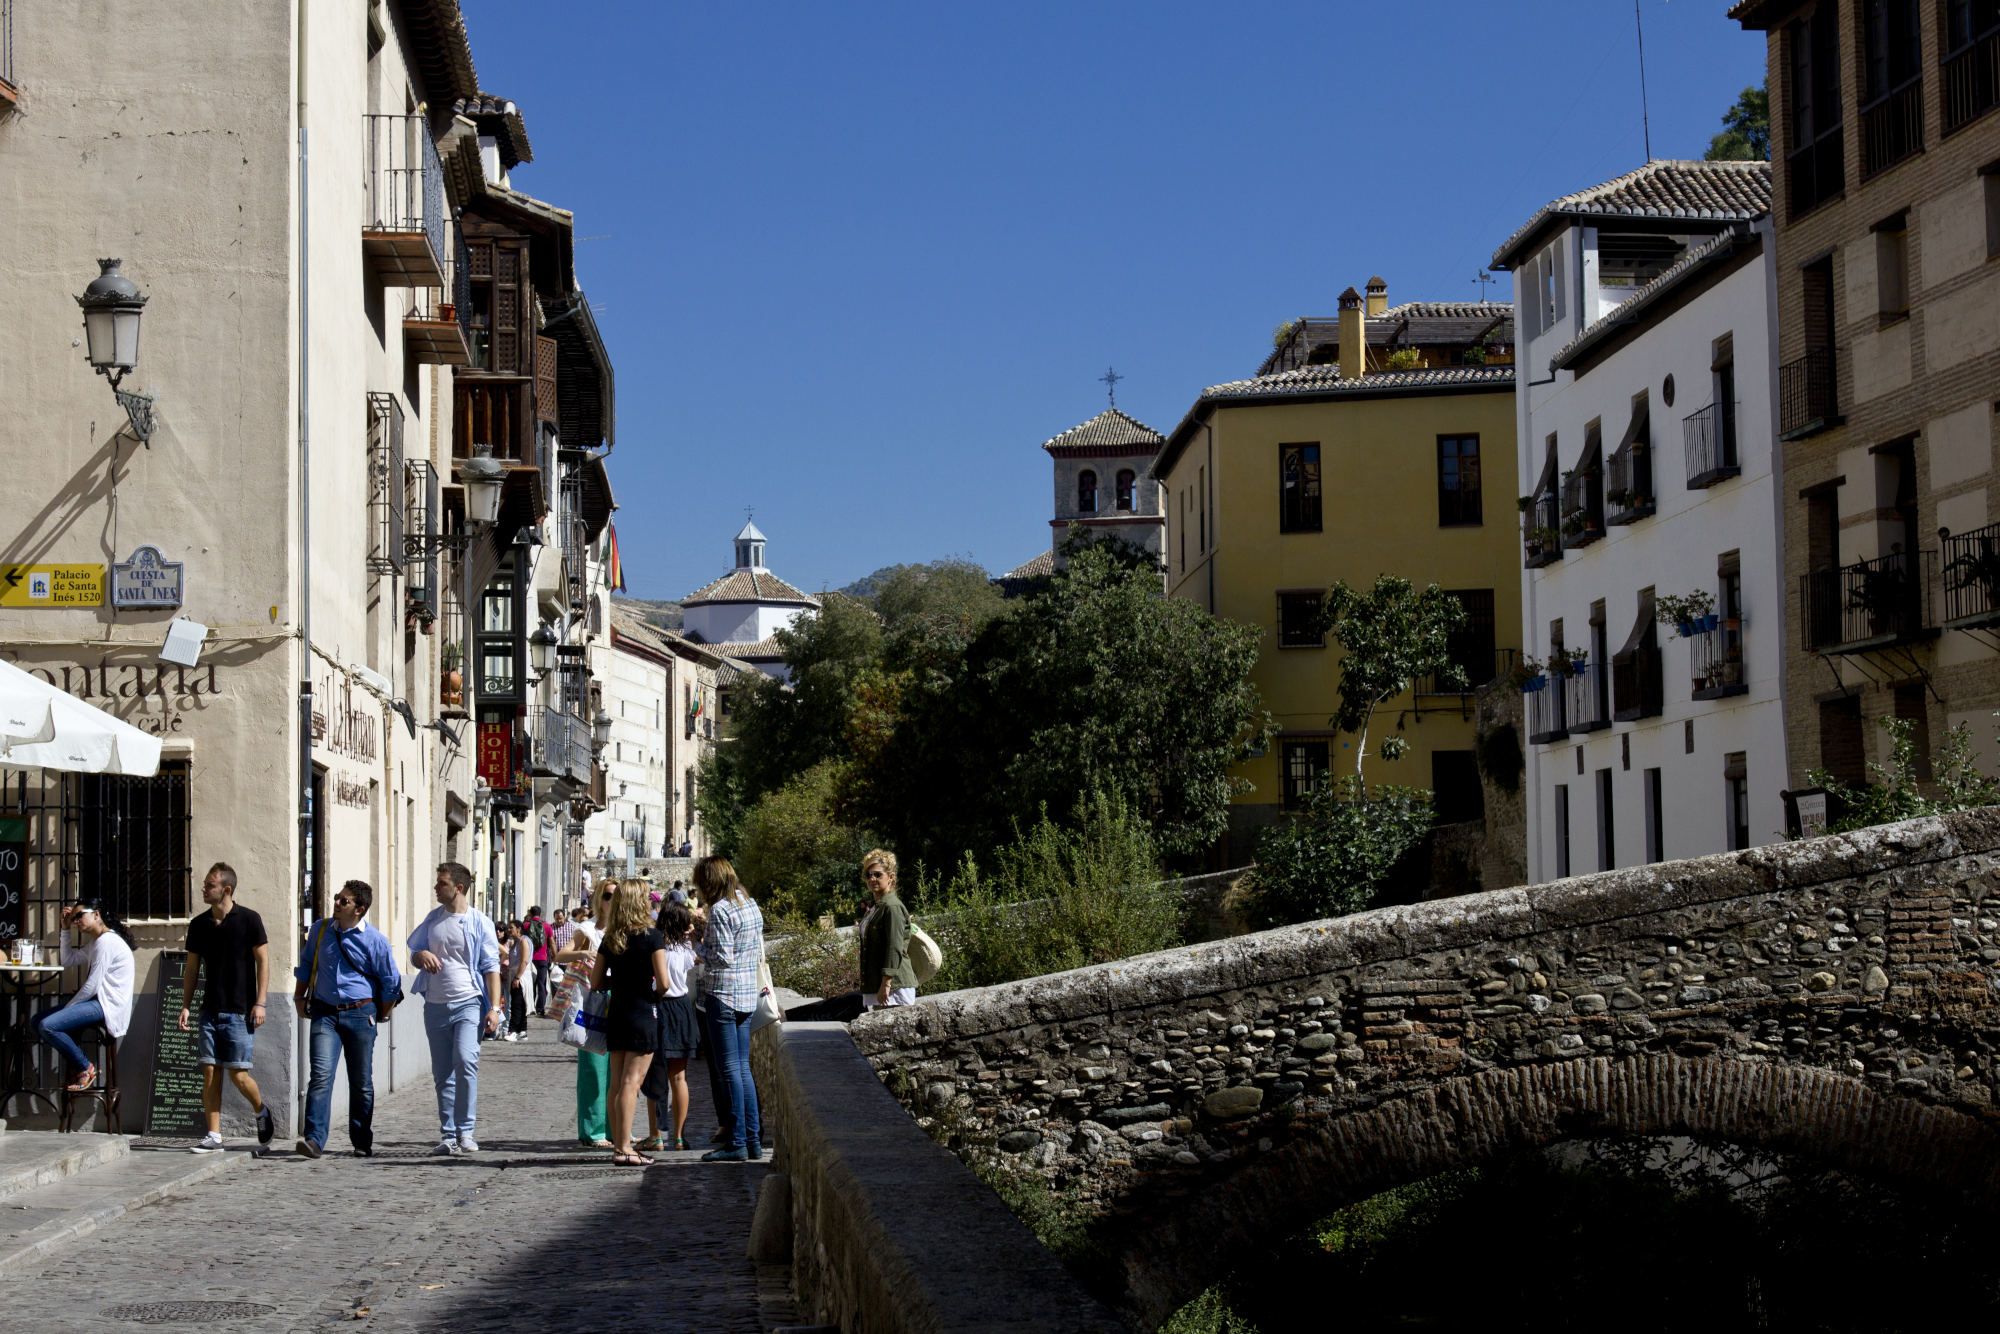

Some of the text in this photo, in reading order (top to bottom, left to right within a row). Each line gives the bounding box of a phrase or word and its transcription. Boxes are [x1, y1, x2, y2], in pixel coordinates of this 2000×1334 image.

[53, 570, 91, 580] Palacio
[130, 571, 166, 580] CUESTA
[53, 581, 97, 591] de Santa
[53, 592, 100, 602] Inés 1520
[118, 587, 177, 600] SANTA INES
[0, 650, 222, 699] ontana
[487, 724, 502, 787] HOTEL
